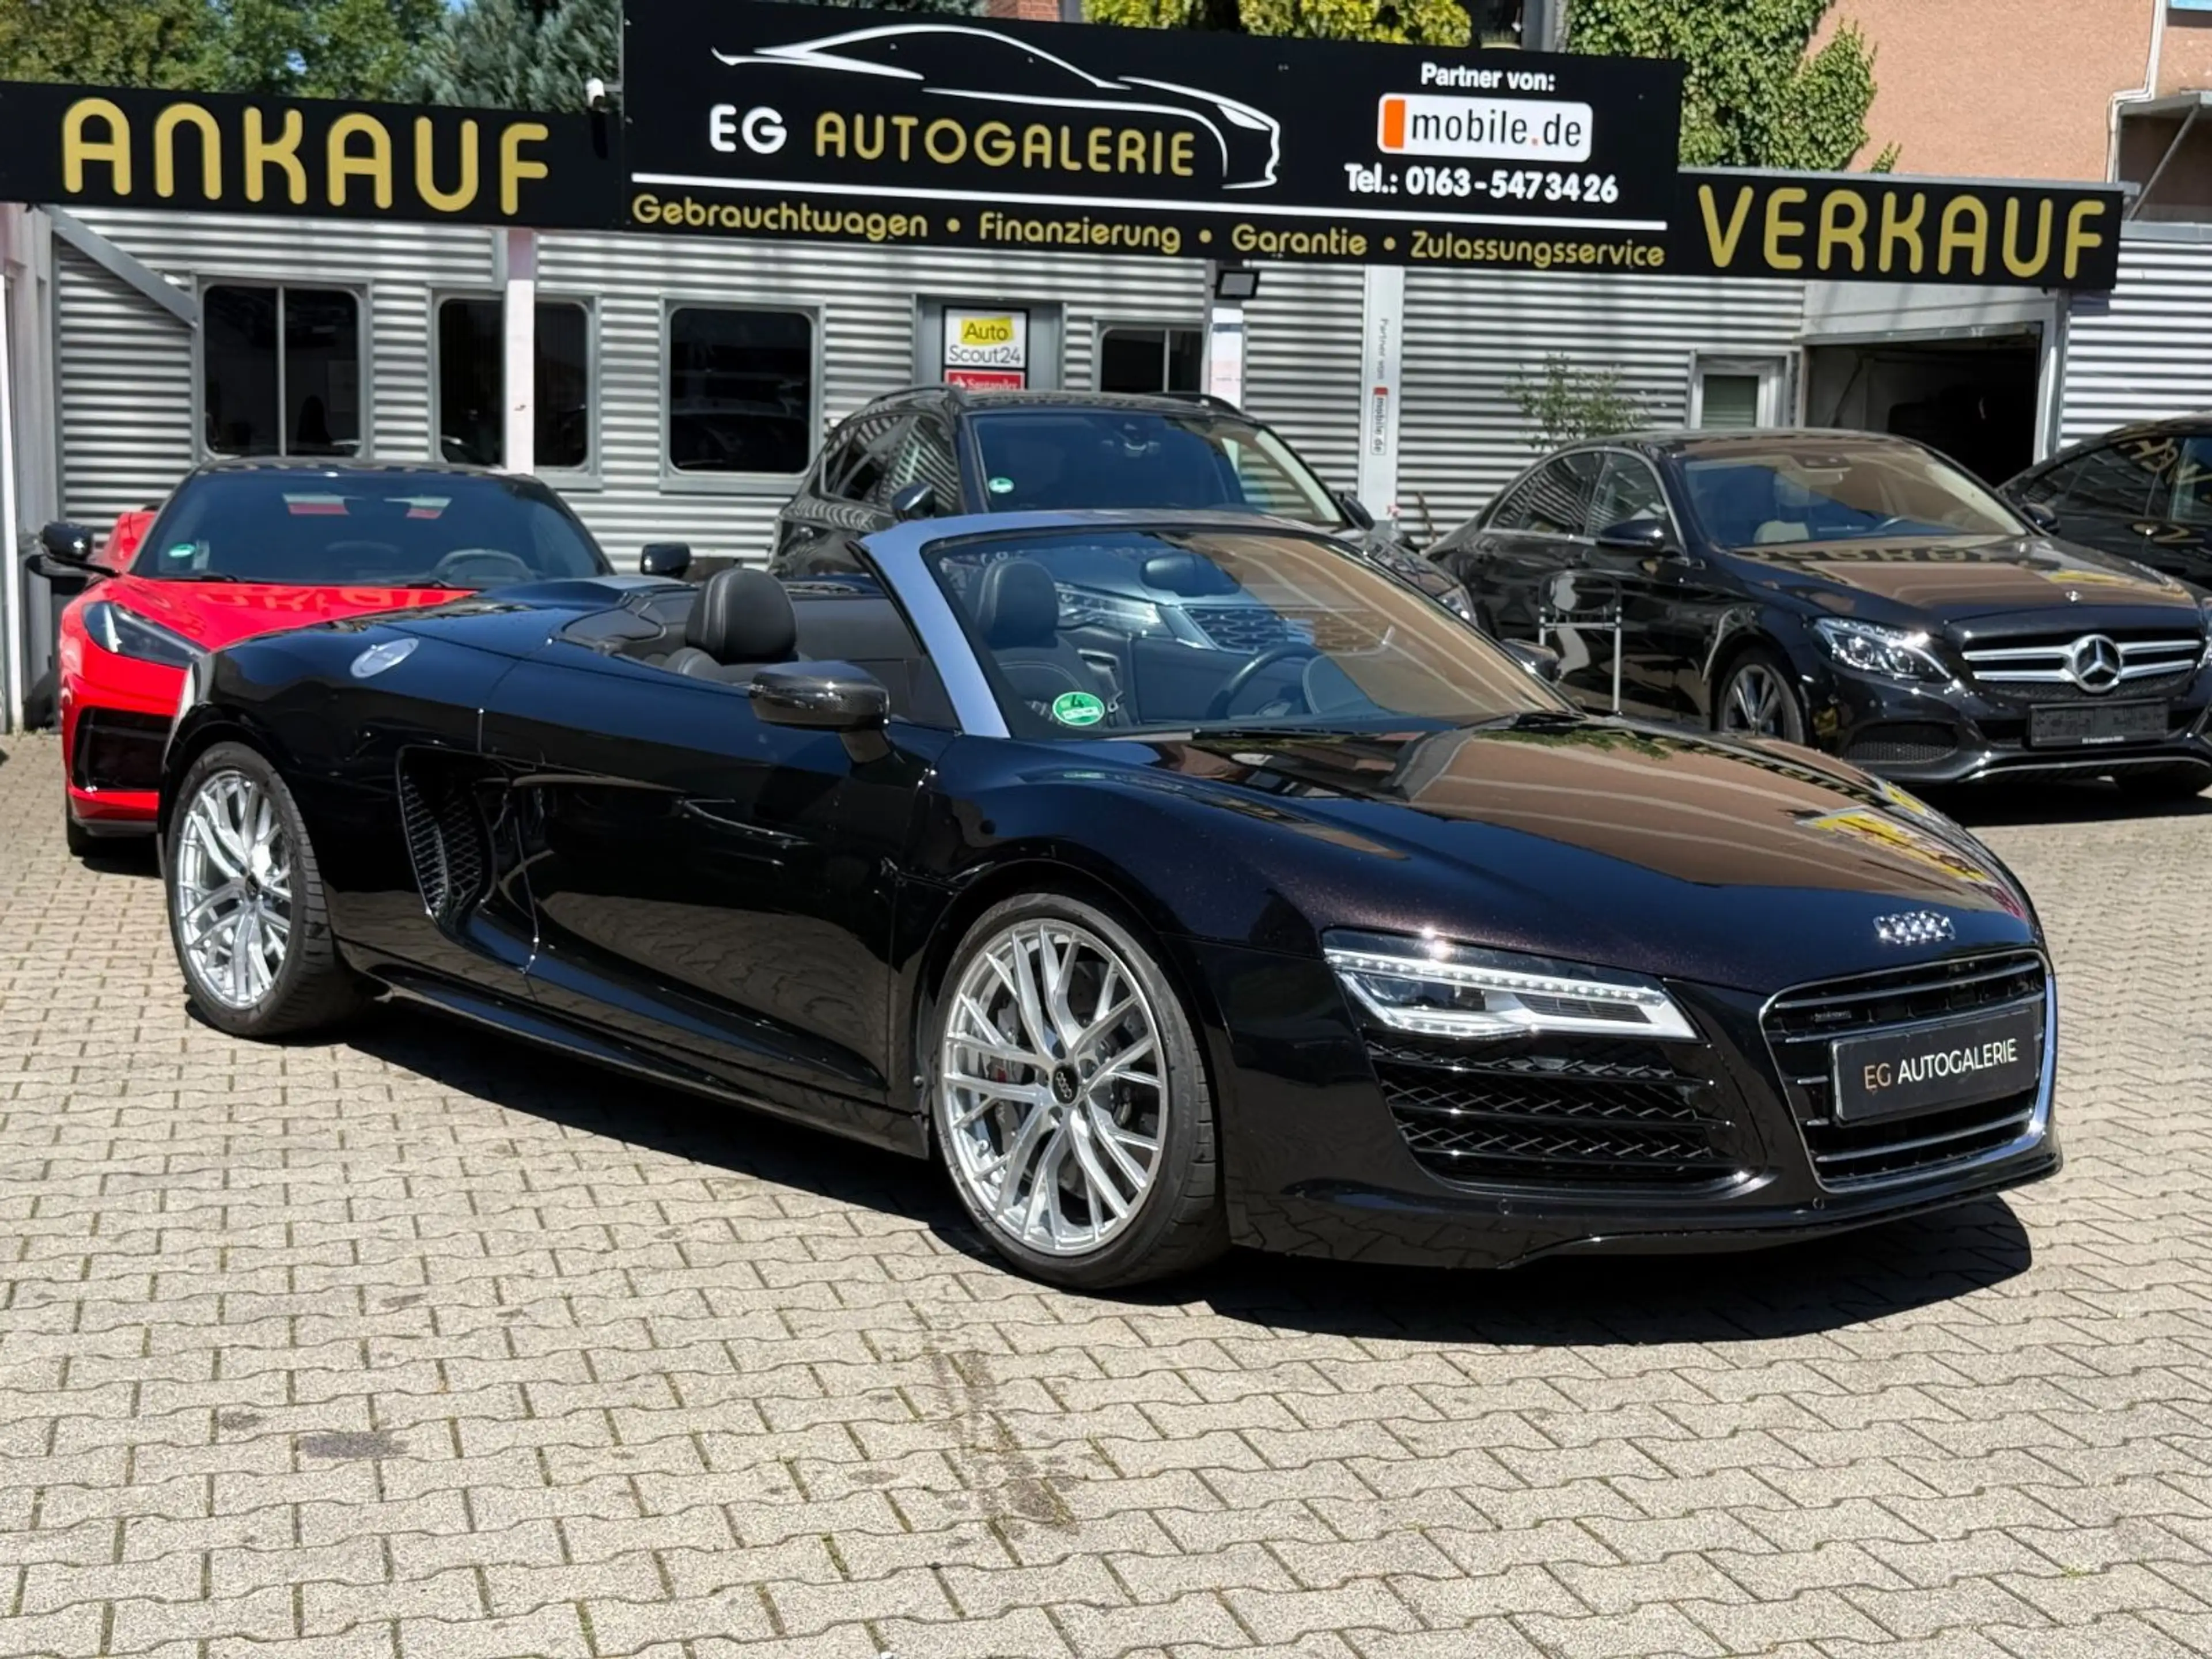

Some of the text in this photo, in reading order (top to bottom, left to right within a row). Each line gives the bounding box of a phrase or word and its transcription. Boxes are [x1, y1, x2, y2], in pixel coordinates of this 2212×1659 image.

[1421, 62, 1555, 91] Partner von:
[709, 104, 1194, 177] EG AUTOGALERIE
[1411, 108, 1582, 147] mobile.de
[63, 98, 548, 215] ANKAUF
[1344, 162, 1399, 194] Tel.:
[632, 194, 1666, 268] Gebrauchtwagen Finanzierung Garantie Zulassungsservice
[1698, 184, 2106, 279] VERKAUF
[949, 344, 1021, 364] Scout24
[964, 322, 1009, 341] Auto
[1373, 397, 1385, 452] mobilede
[1863, 1038, 2018, 1090] EG AUTOGALERIE
